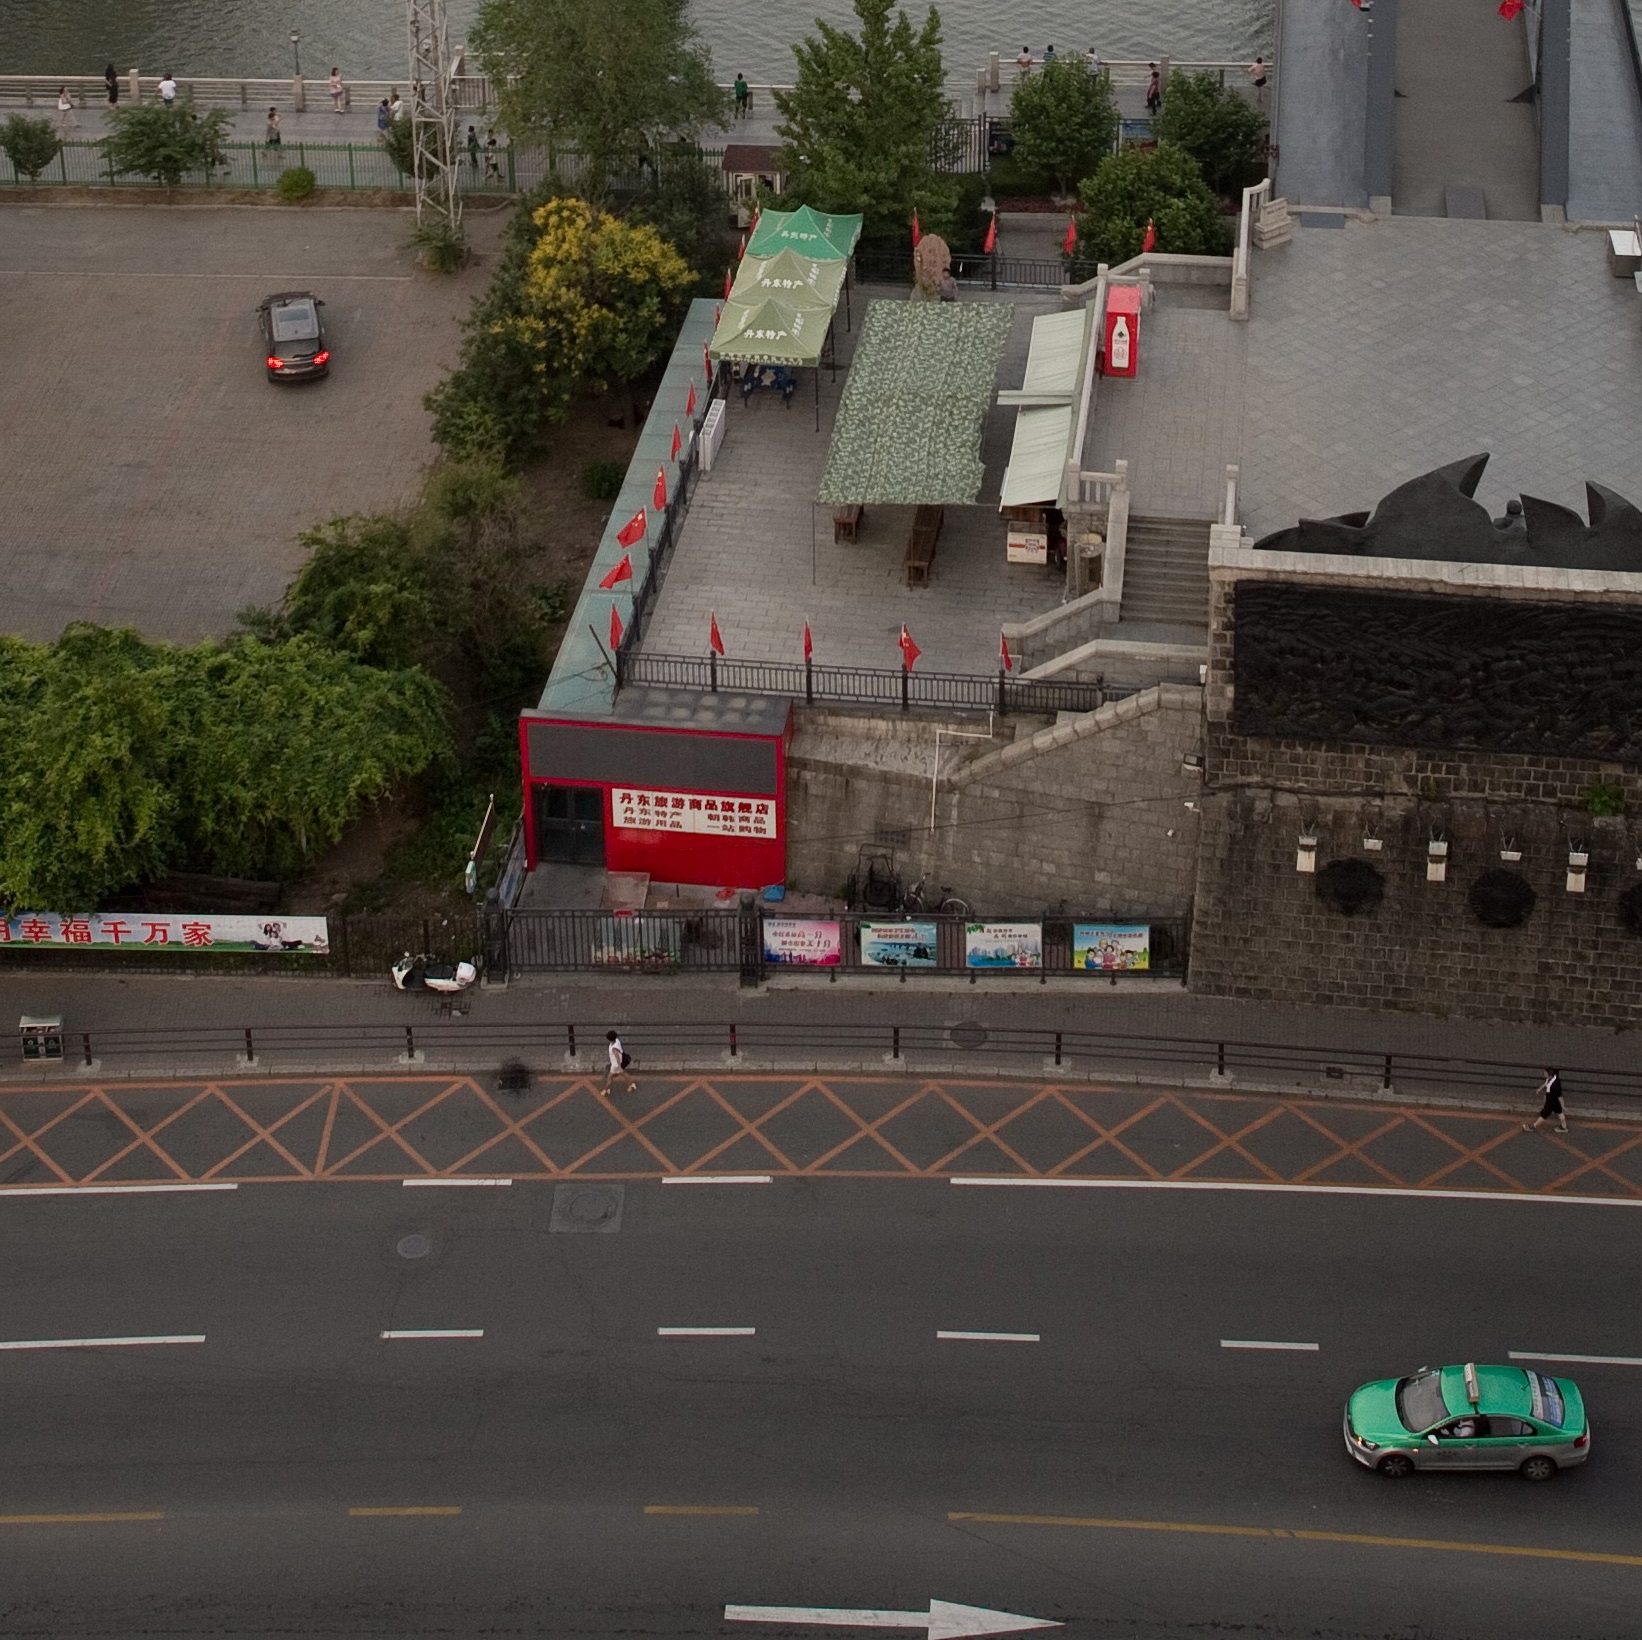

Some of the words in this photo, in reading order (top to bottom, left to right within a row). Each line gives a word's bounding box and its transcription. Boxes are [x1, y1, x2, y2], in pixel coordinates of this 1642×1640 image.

[761, 277, 803, 289] 丹东特产
[744, 329, 787, 340] 丹东特产
[619, 792, 769, 815] 丹东旅游商品旗舰店
[623, 806, 682, 818] 丹东特产
[707, 813, 766, 825] 朝韩商品
[623, 816, 682, 828] 旅游用品
[707, 823, 767, 834] 一站购物
